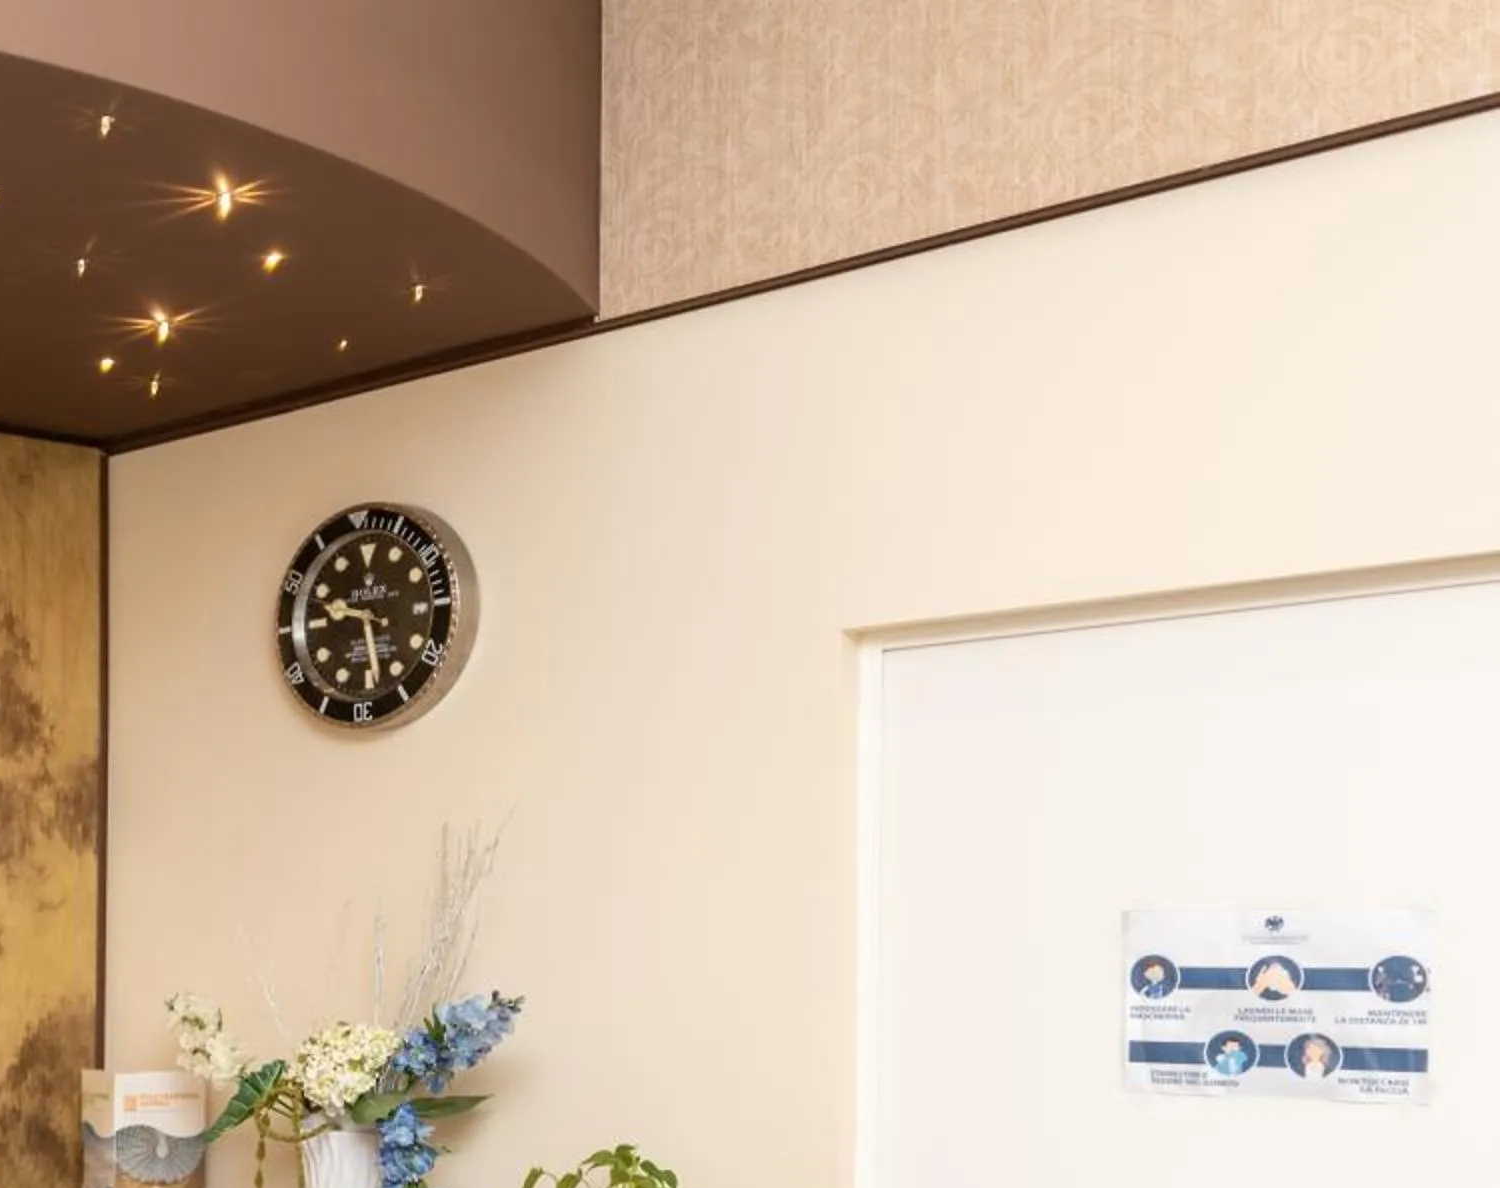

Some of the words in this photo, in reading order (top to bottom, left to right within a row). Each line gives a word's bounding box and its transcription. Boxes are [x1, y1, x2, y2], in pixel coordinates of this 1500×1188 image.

[285, 571, 302, 594] 50
[421, 638, 443, 665] 20
[353, 702, 373, 722] 30
